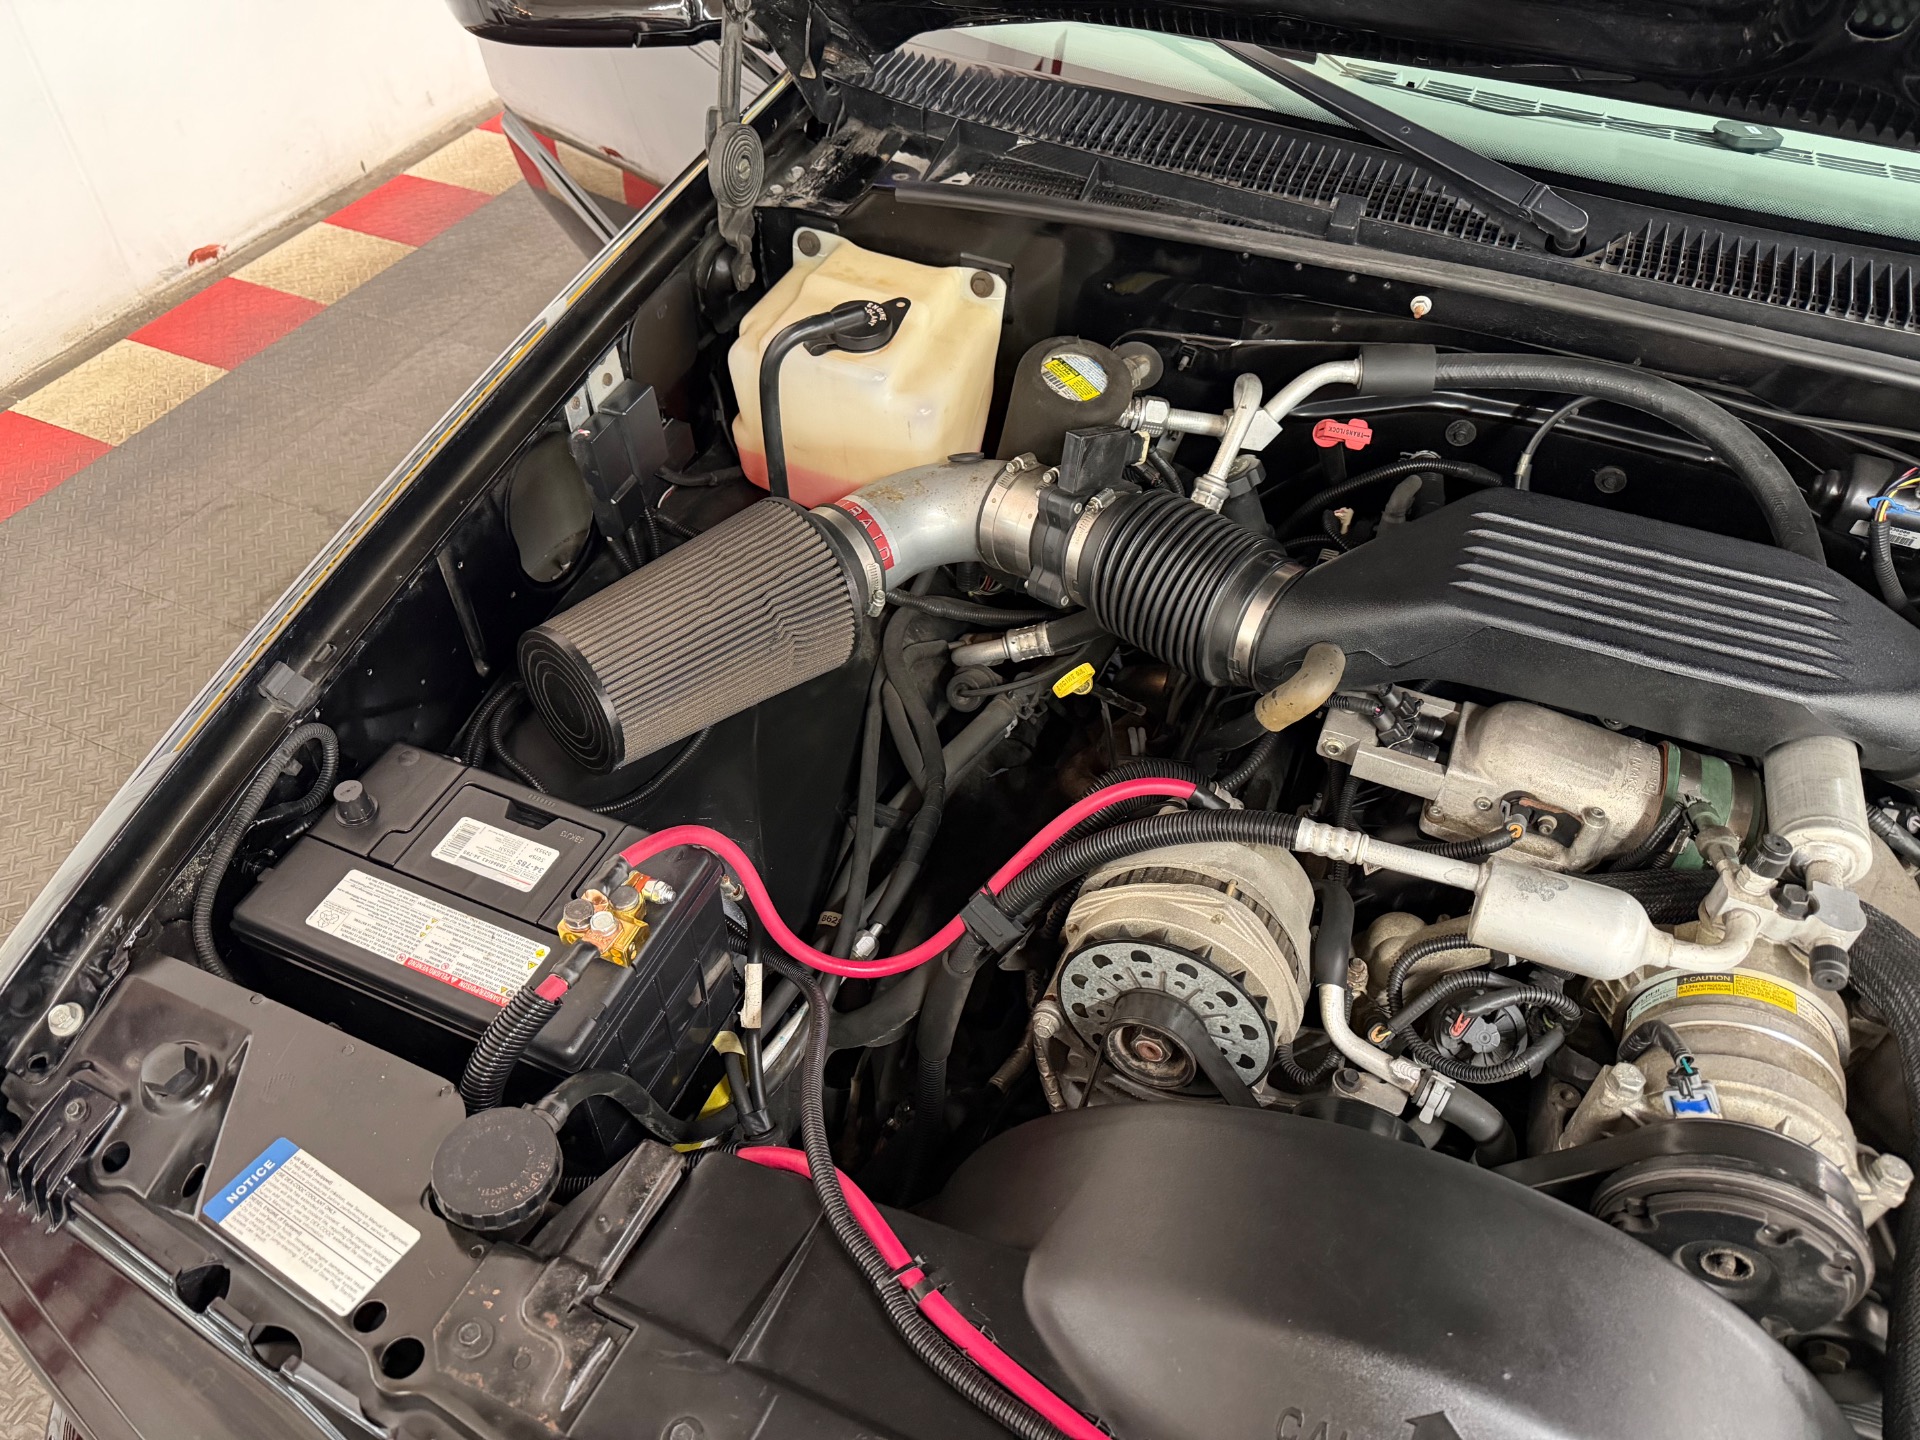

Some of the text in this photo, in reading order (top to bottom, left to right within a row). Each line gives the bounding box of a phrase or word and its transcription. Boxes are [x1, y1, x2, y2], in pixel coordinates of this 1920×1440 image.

[1329, 426, 1364, 438] TRANS/LOCK
[514, 858, 545, 873] 34-78S
[821, 914, 841, 925] 862
[1690, 974, 1731, 983] CAUTION
[225, 1158, 276, 1205] NOTICE
